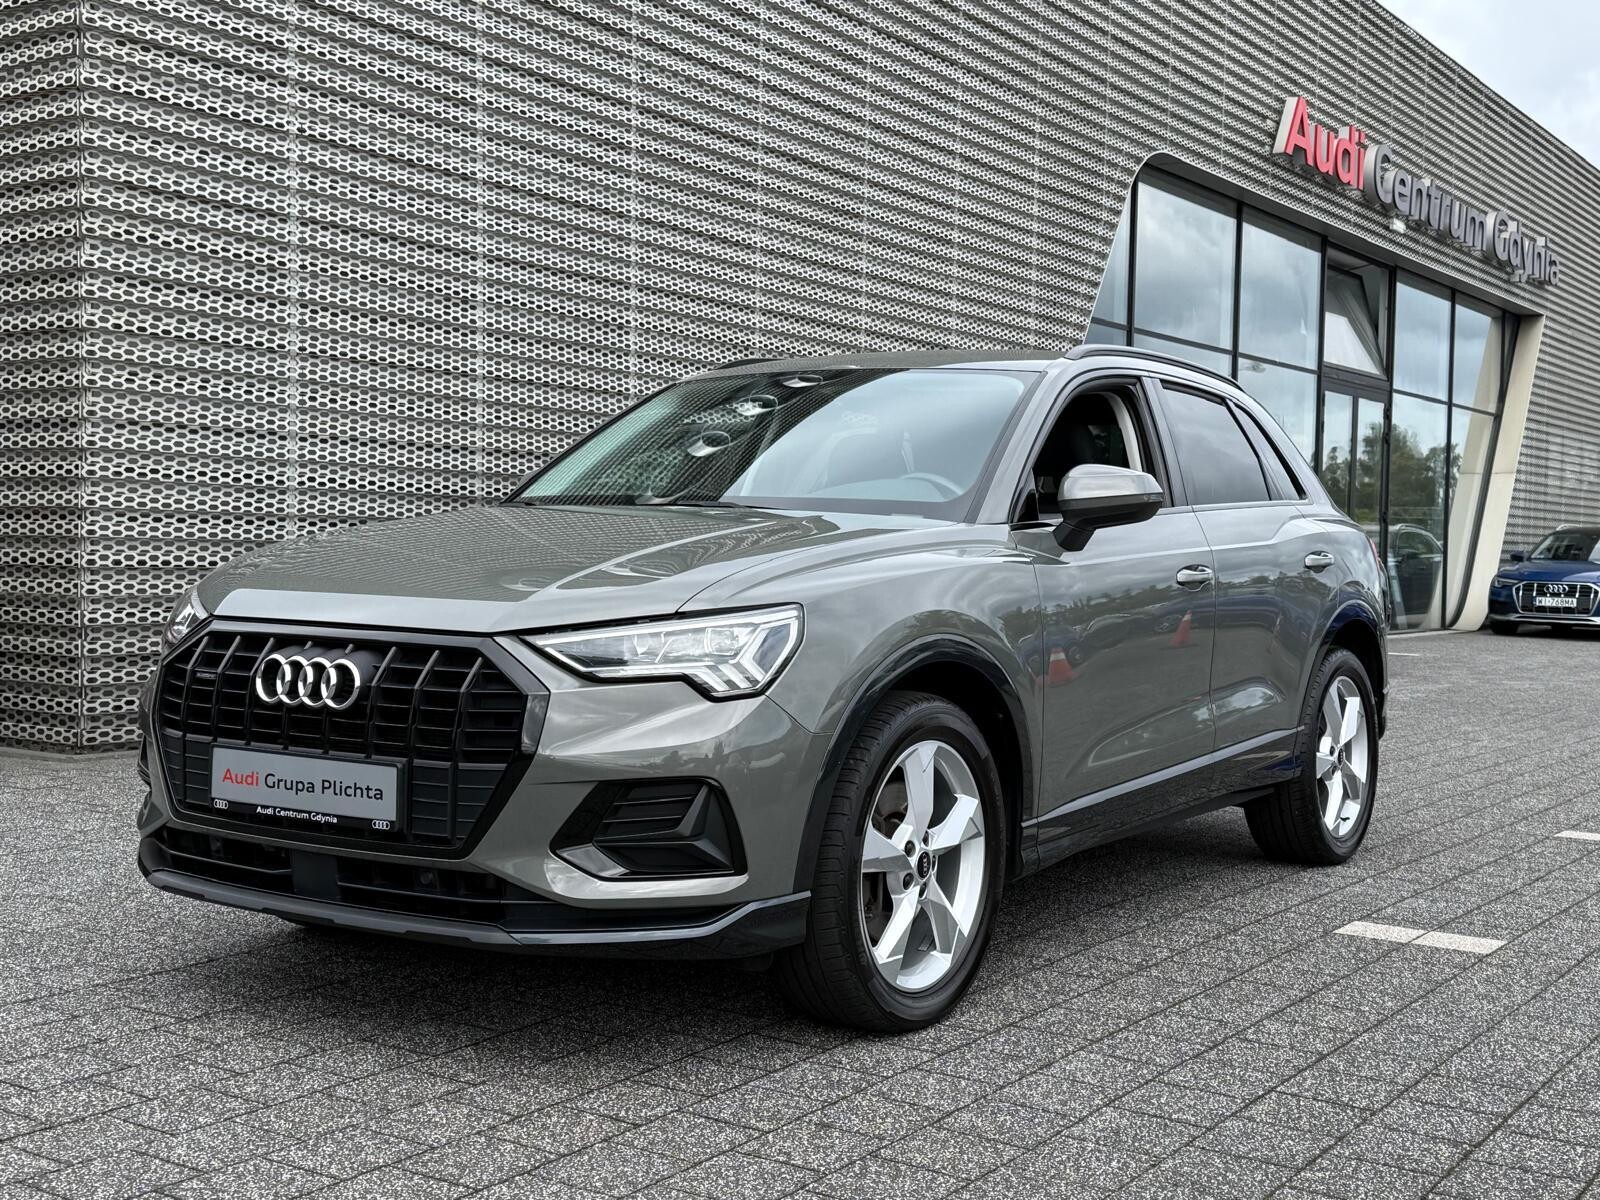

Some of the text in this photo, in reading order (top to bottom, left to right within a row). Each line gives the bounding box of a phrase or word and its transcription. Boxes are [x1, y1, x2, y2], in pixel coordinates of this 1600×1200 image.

[1273, 96, 1560, 286] Audi Centrum Gdynia
[222, 768, 384, 801] Audi Grupa Plichta
[256, 806, 338, 824] Audi Centrum Gdynia
